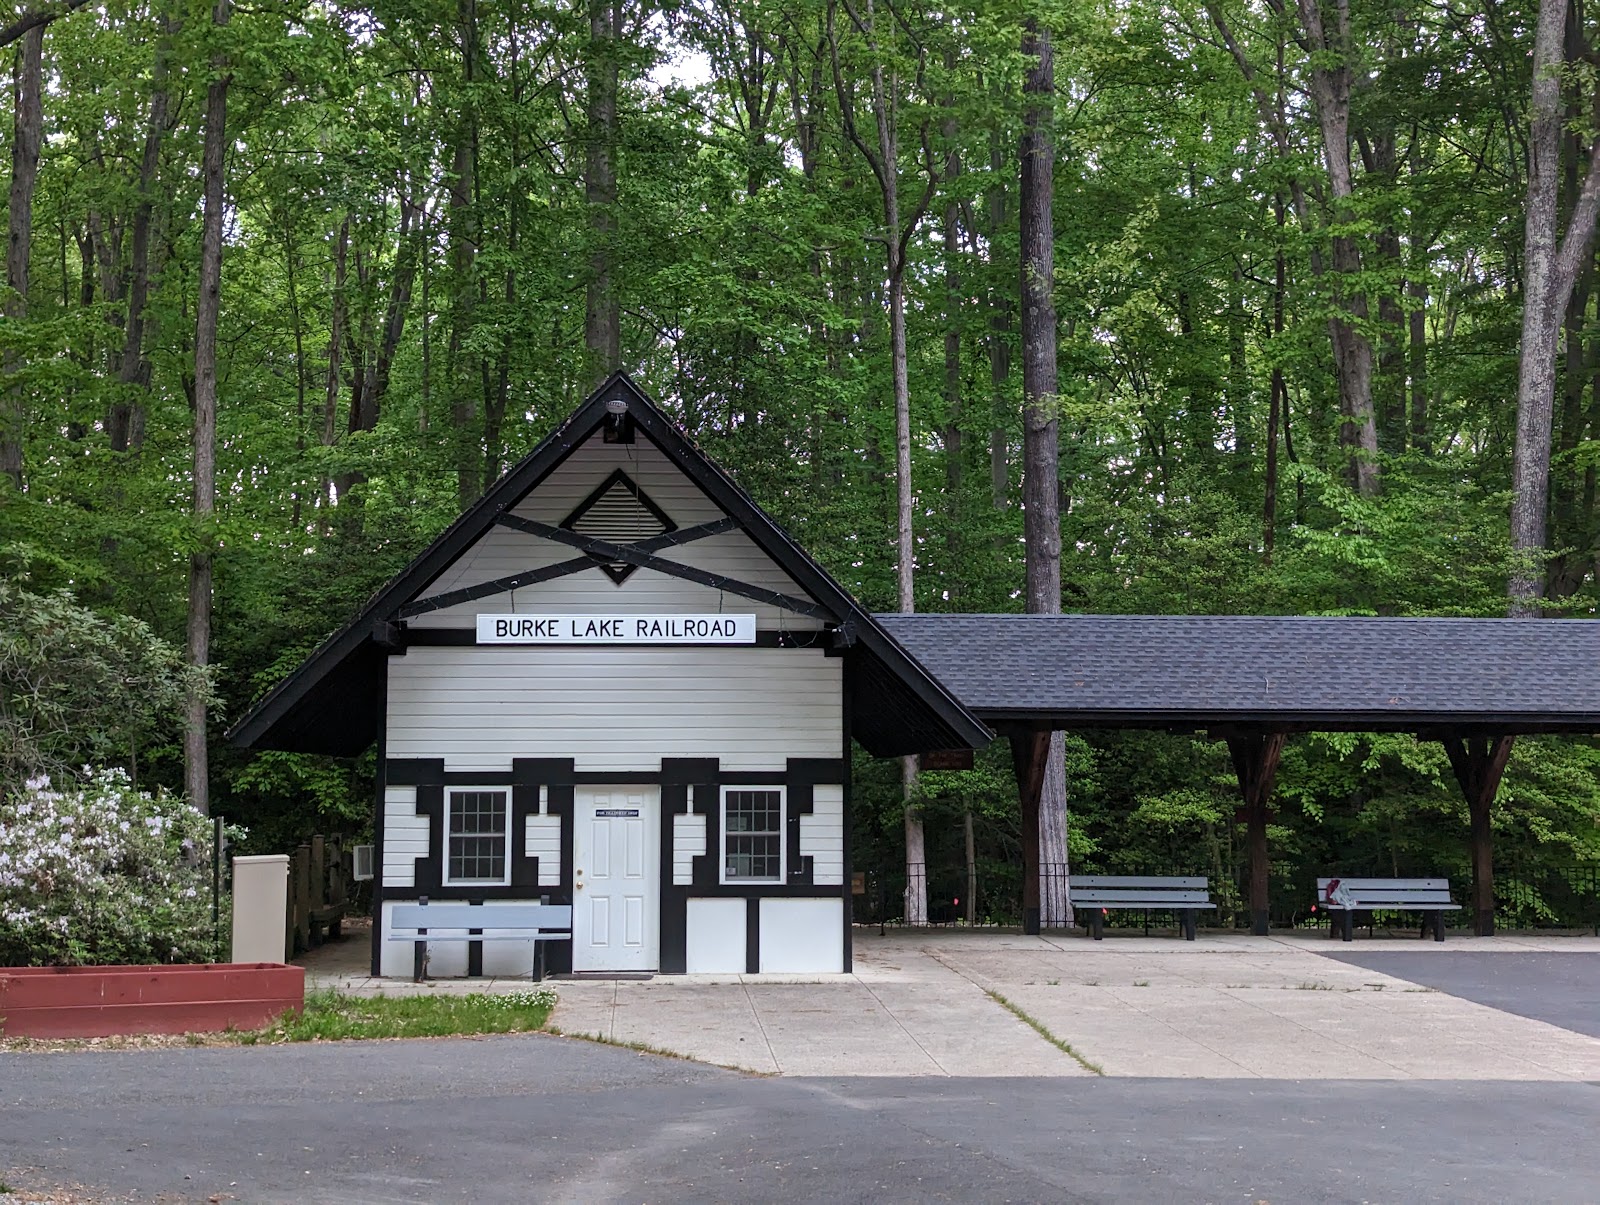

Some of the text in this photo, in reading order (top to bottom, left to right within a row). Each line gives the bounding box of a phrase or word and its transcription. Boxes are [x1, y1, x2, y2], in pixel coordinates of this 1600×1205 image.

[496, 619, 736, 637] BURKE LAKE RAILROAD
